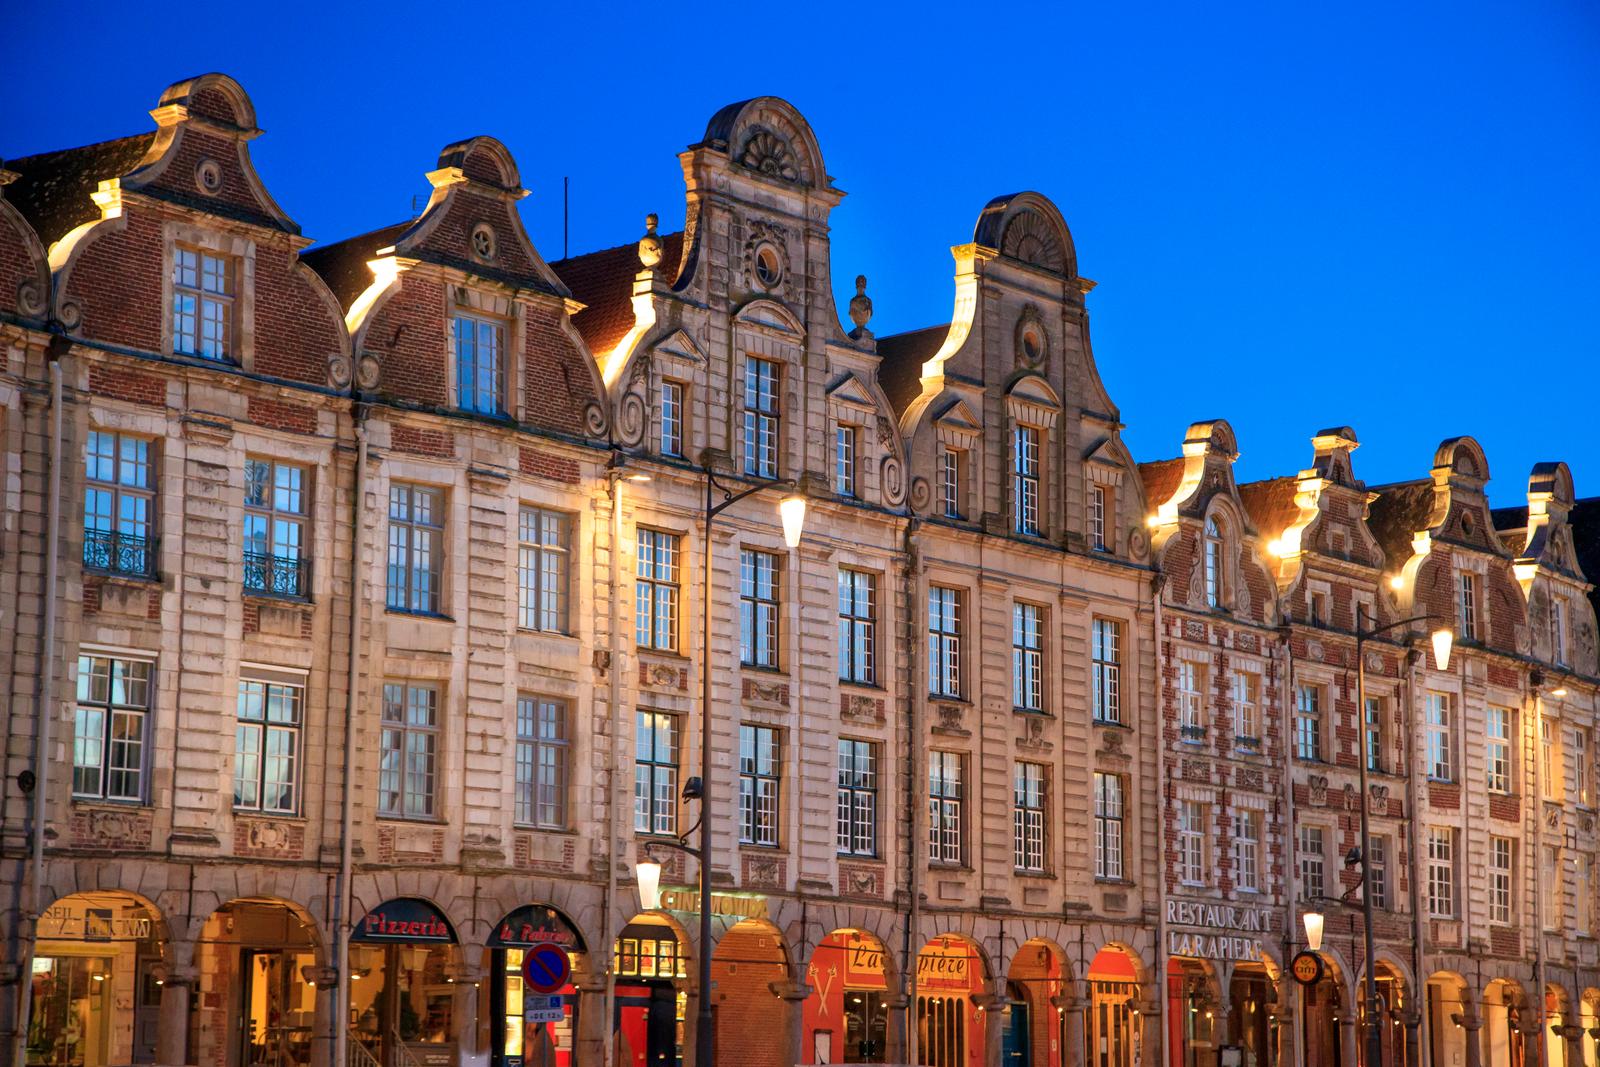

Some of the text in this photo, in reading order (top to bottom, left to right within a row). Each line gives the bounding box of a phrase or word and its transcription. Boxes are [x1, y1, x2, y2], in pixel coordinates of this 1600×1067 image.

[365, 912, 447, 936] Pizzeria
[1166, 900, 1272, 931] RESTAURANT
[852, 944, 966, 974] La pière
